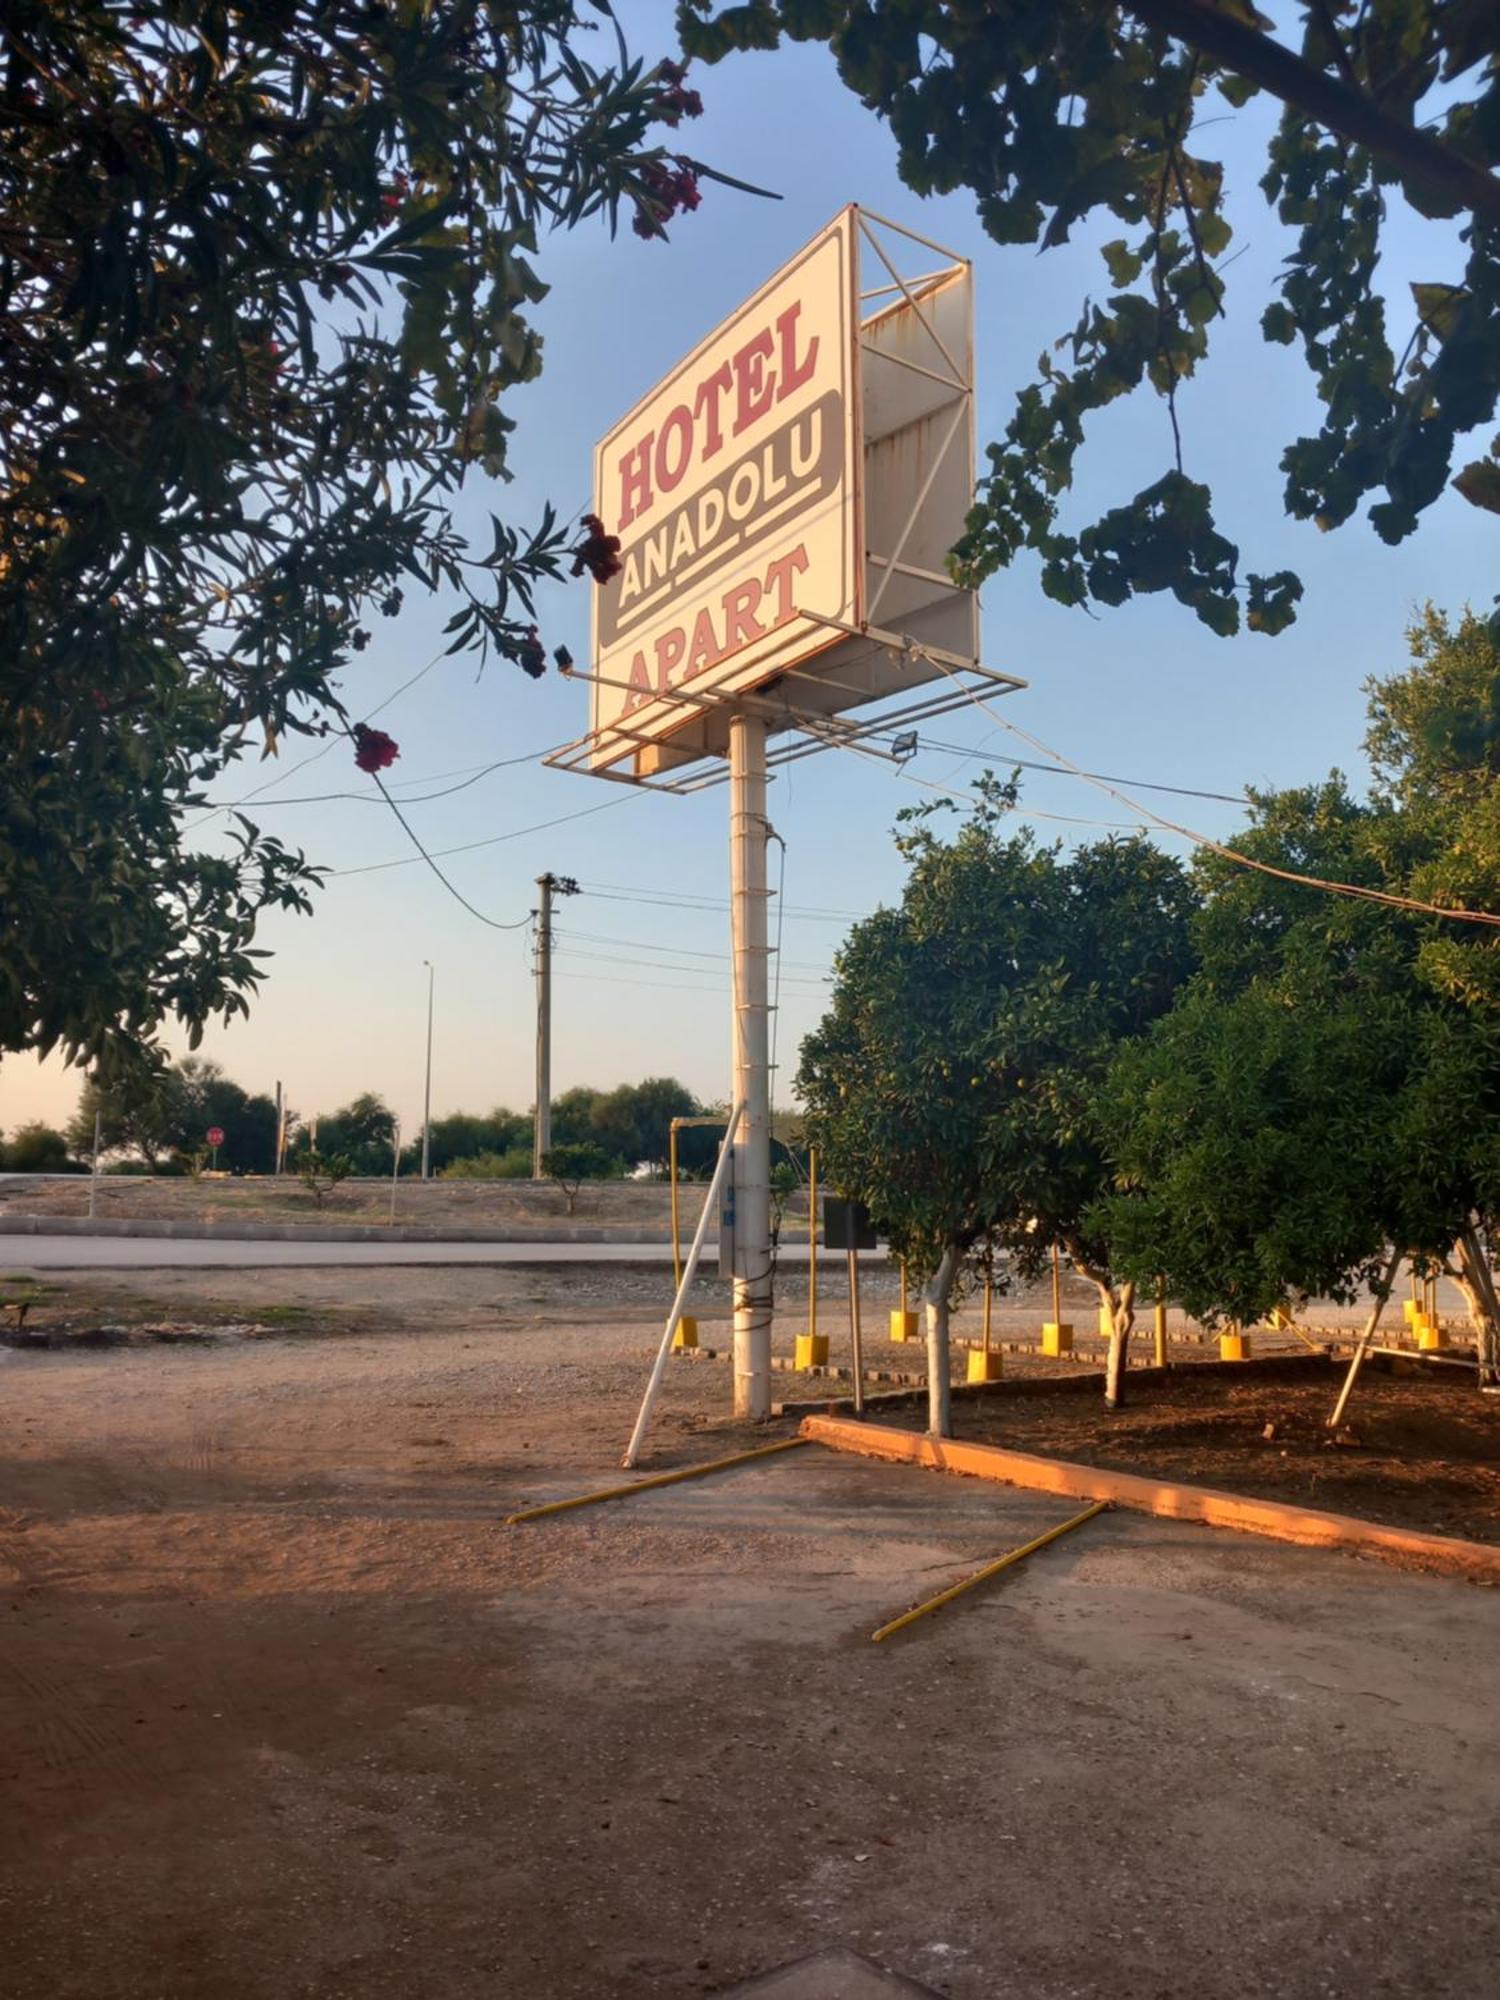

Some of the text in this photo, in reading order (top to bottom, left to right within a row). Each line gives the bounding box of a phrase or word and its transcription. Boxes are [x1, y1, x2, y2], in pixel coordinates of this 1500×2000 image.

[618, 298, 820, 534] HOTEL
[618, 407, 822, 608] ANADOLU
[621, 542, 810, 718] APART
